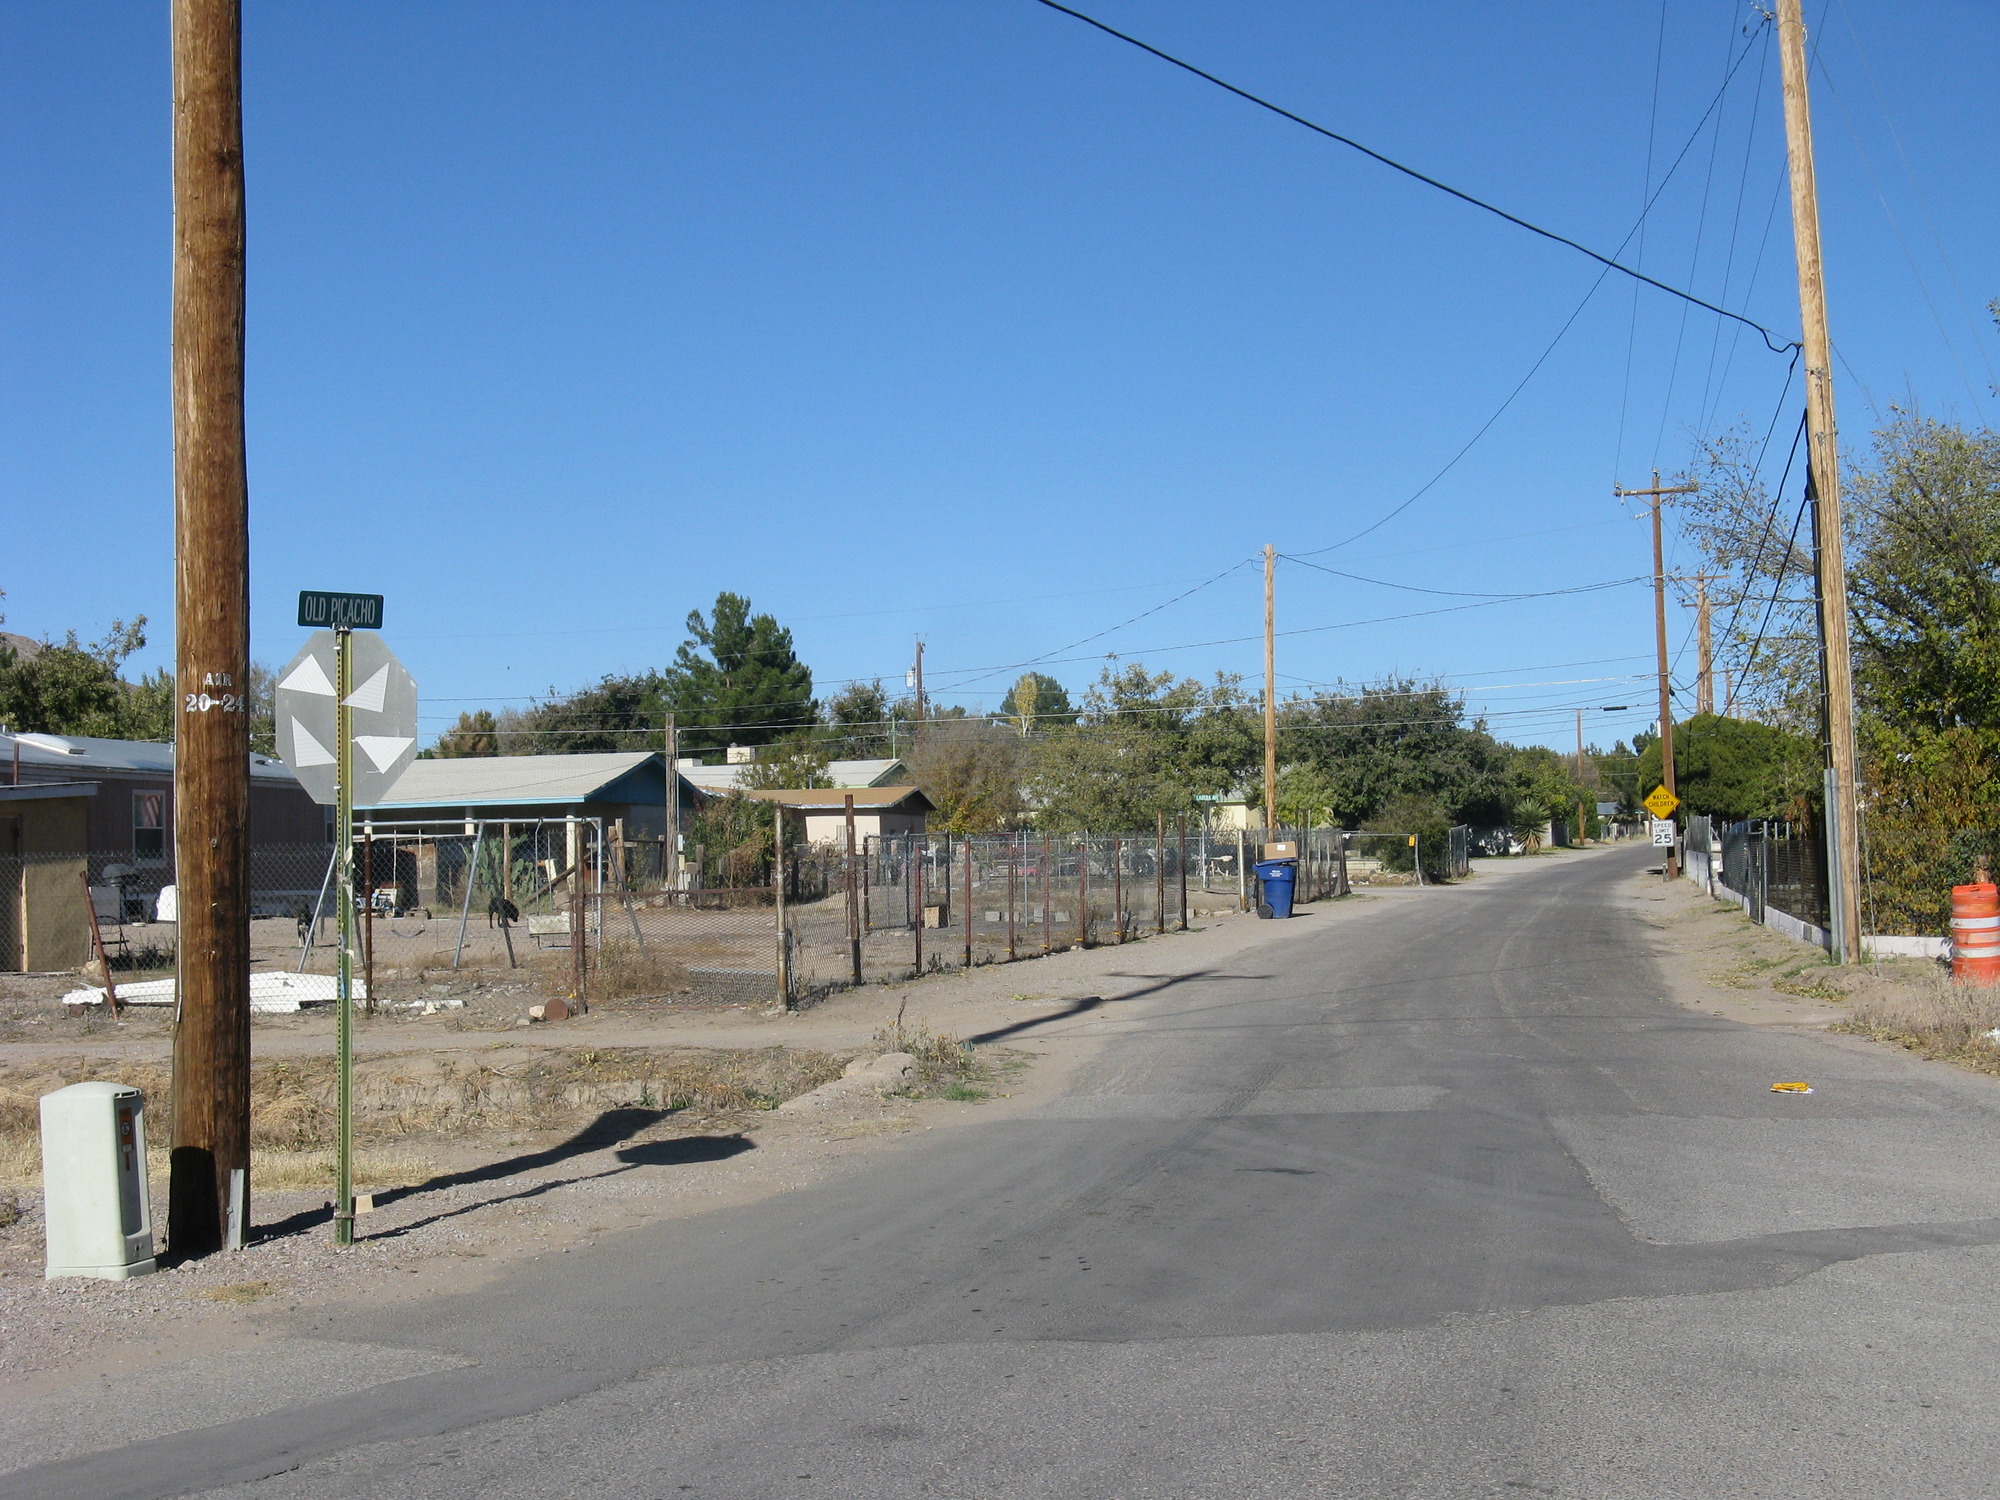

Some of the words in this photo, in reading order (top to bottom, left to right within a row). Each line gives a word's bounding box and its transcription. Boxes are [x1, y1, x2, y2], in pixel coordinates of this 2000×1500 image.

[304, 596, 326, 621] OLD
[330, 597, 376, 624] PICACHO
[205, 672, 232, 687] AIR
[185, 693, 245, 713] 20-24
[1655, 834, 1671, 843] 25
